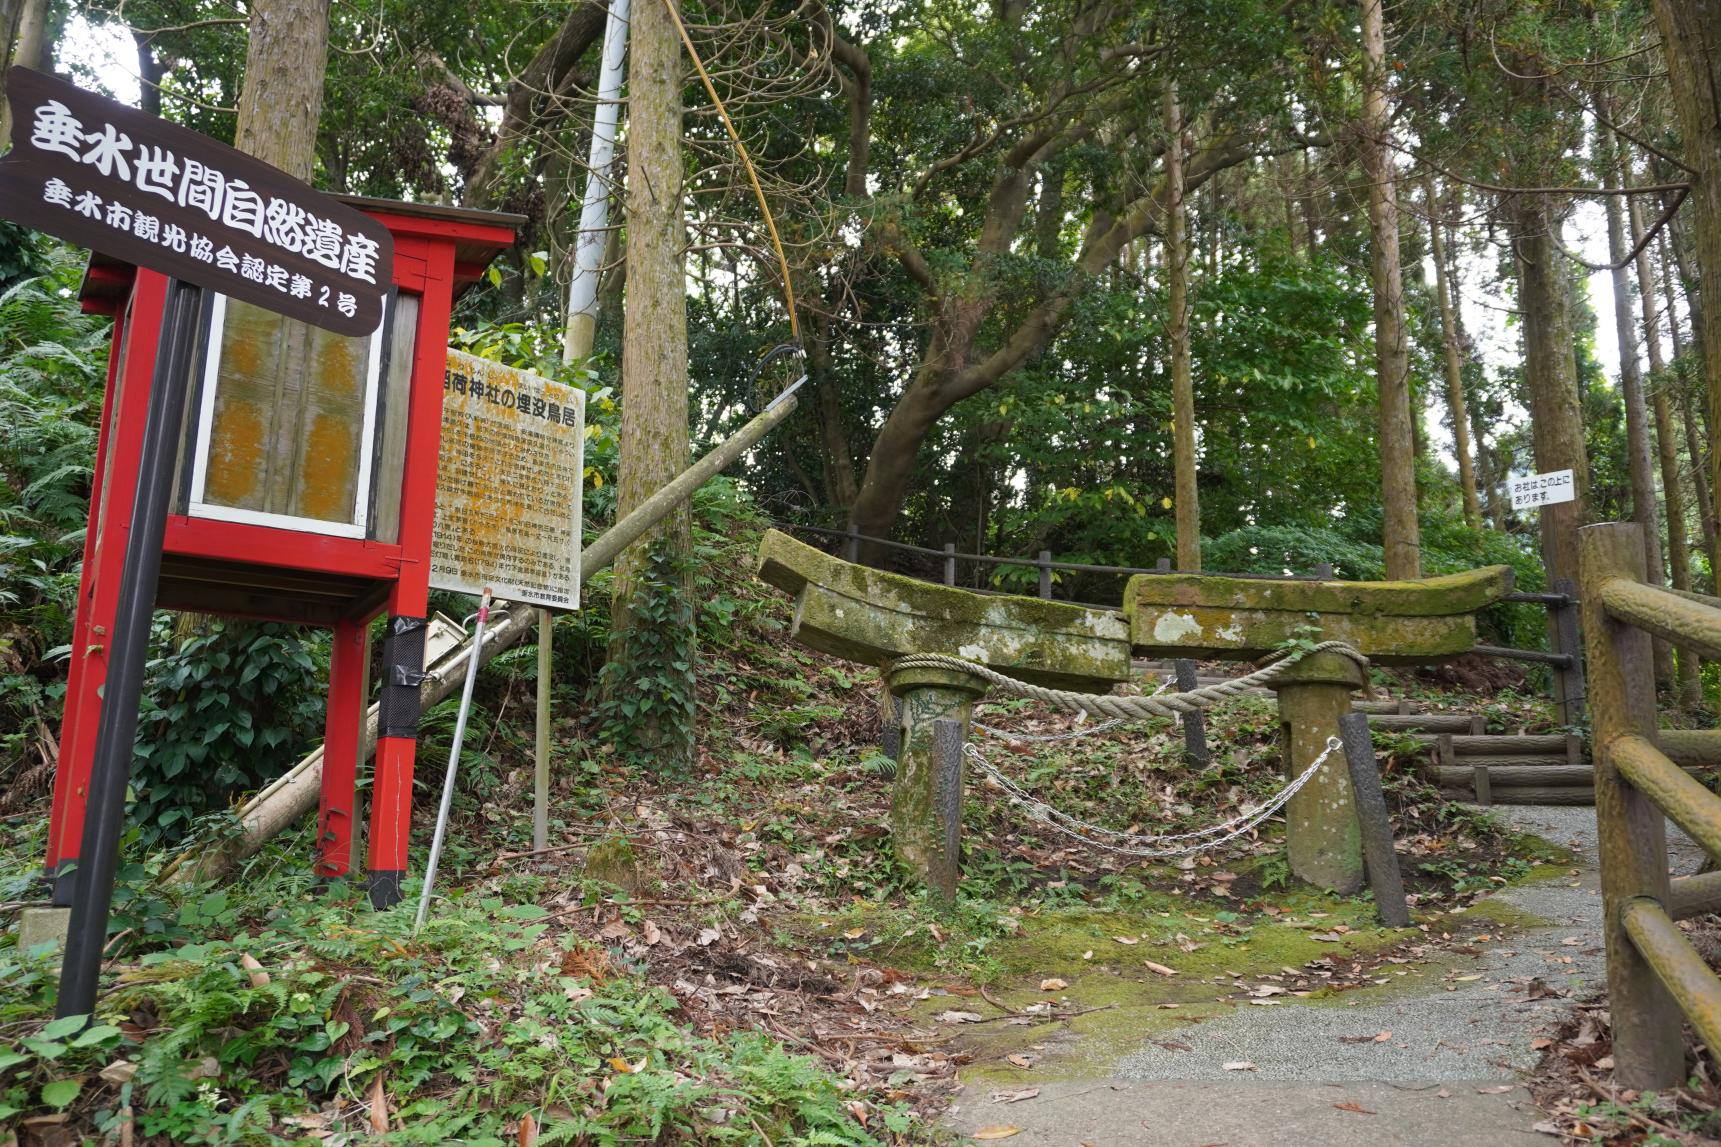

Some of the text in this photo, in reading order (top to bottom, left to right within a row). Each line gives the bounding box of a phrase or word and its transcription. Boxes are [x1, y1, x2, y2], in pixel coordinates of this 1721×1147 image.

[30, 99, 380, 285] 垂水世間自然遺産
